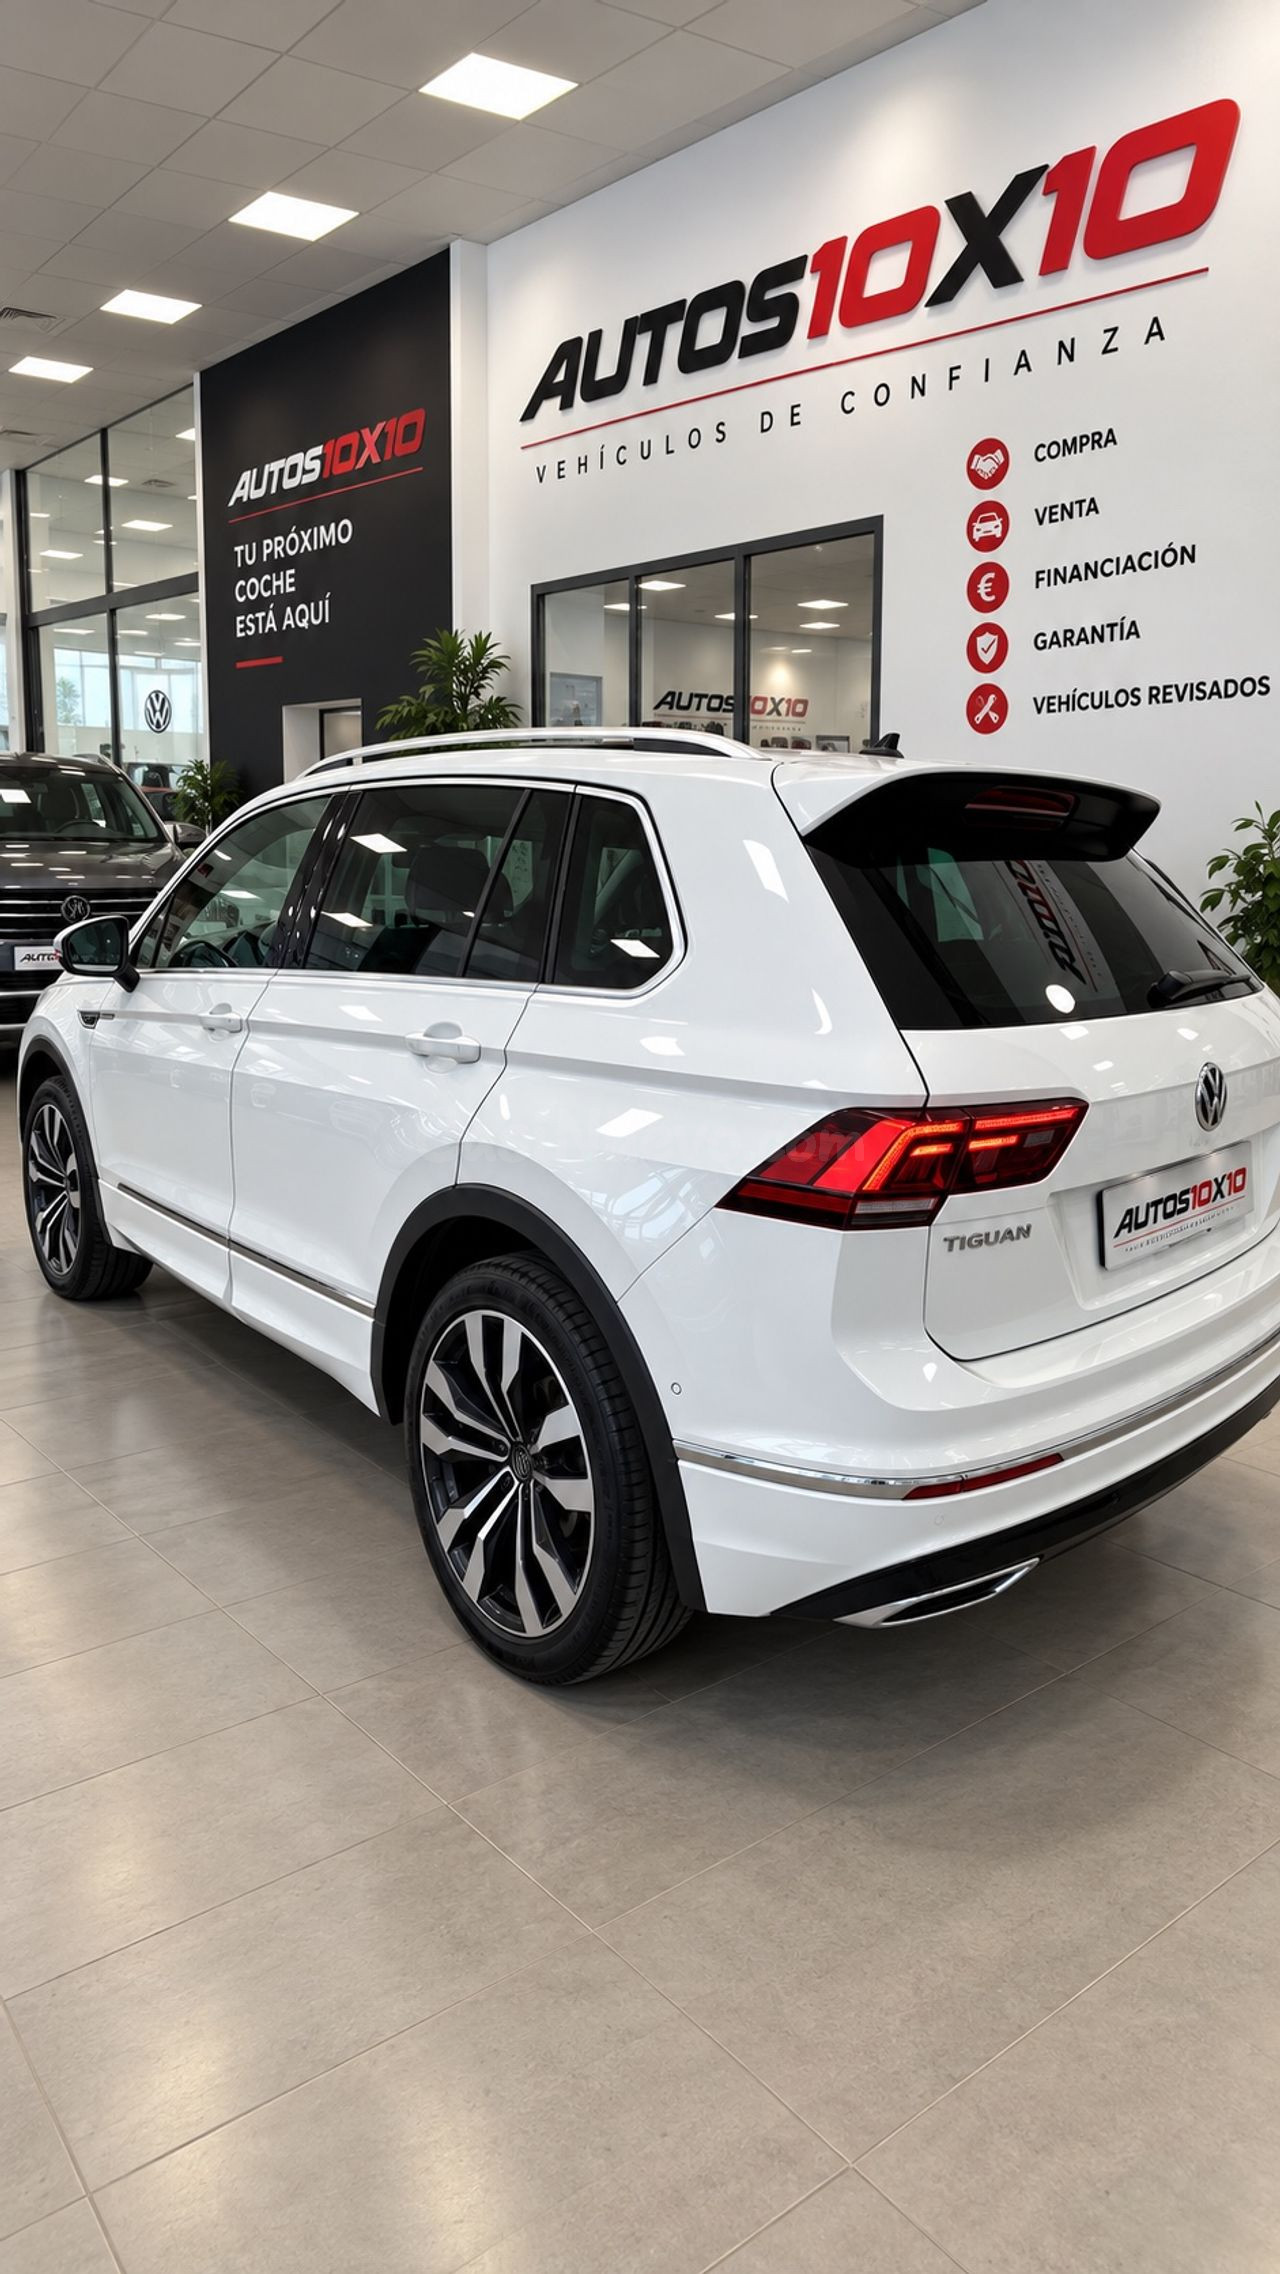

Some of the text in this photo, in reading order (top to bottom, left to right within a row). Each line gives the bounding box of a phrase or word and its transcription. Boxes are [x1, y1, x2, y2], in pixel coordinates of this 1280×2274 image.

[520, 98, 1240, 422] AUTOS10X10
[536, 316, 1165, 484] VEHÍCULOS DE CONFIANZA
[228, 408, 426, 507] AUTOS10X10
[1034, 428, 1118, 462] COMPRA
[1034, 497, 1100, 526] VENTA
[234, 519, 353, 567] TU PRÓXIMO
[235, 569, 296, 602] COCHE
[1034, 542, 1196, 589] FINANCIACIÓN
[236, 592, 332, 638] ESTÁ AQUÍ
[1033, 616, 1141, 651] GARANTÍA
[653, 691, 809, 718] AUTOS0X10
[1033, 675, 1271, 715] VEHÍCULOS REVISADOS
[1113, 1167, 1247, 1239] AUTOS10X10
[943, 1223, 1032, 1252] TIGUAN
